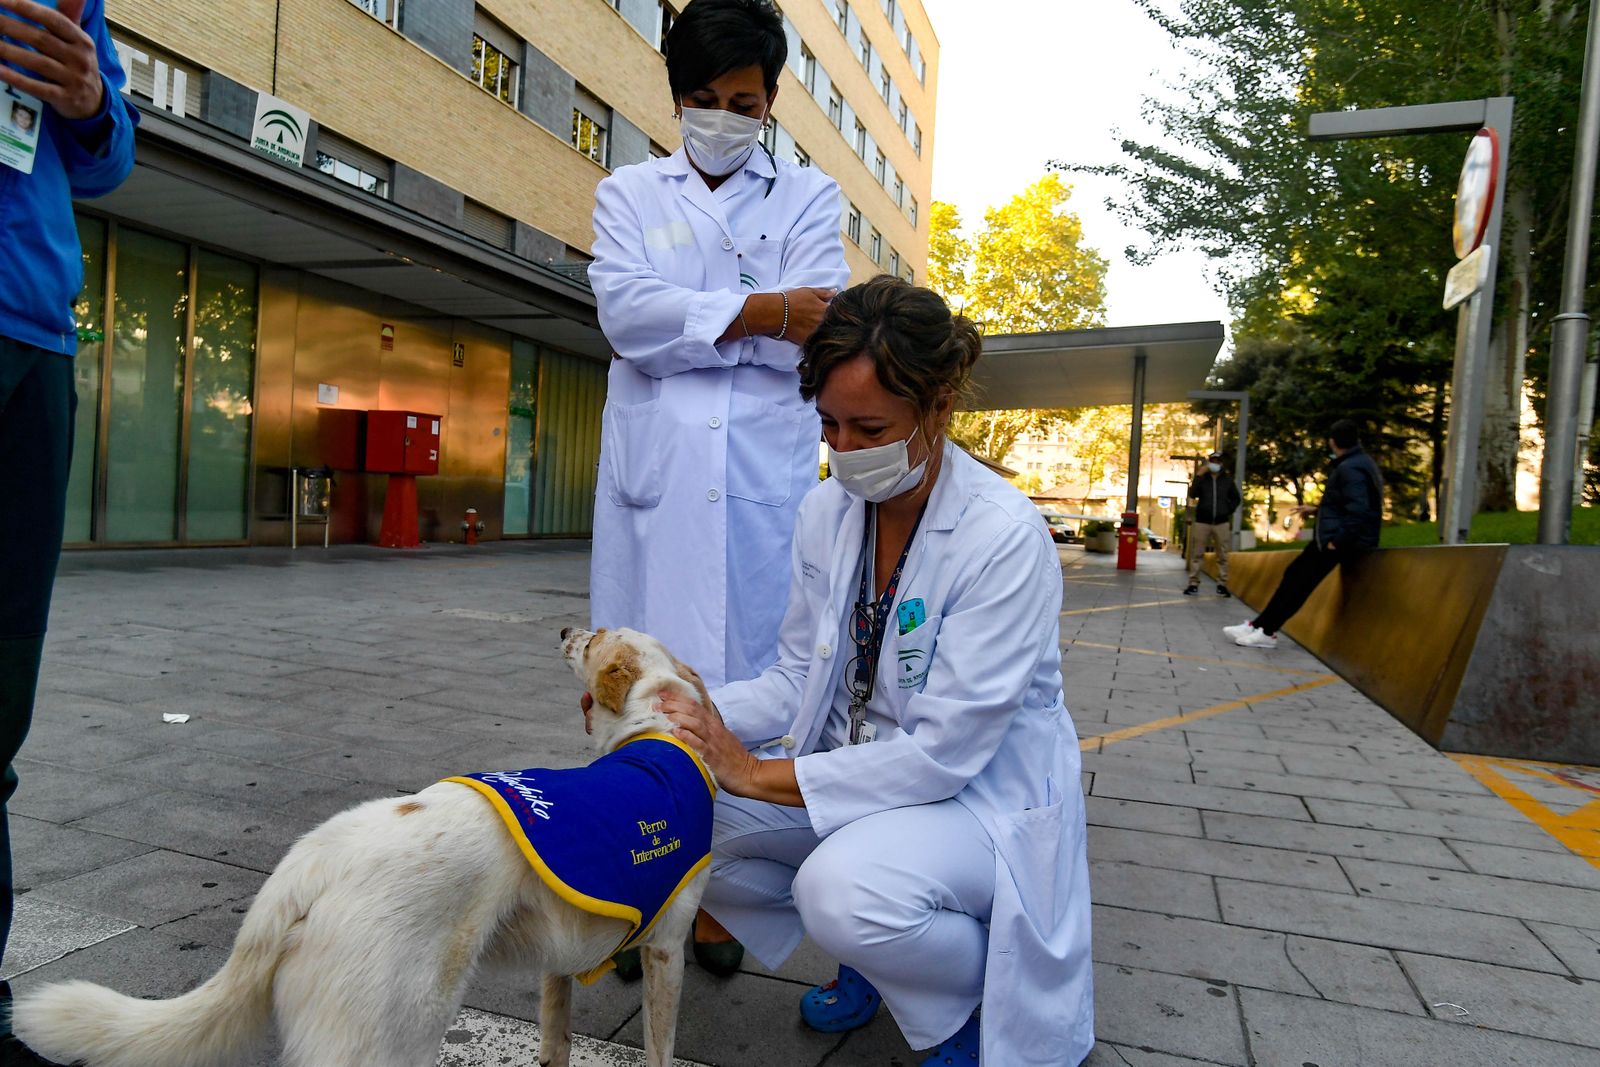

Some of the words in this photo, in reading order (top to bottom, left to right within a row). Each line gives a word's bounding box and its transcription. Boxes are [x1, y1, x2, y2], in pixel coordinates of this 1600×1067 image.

[637, 819, 667, 836] Perro
[652, 835, 661, 846] de
[630, 836, 681, 865] Intervención
